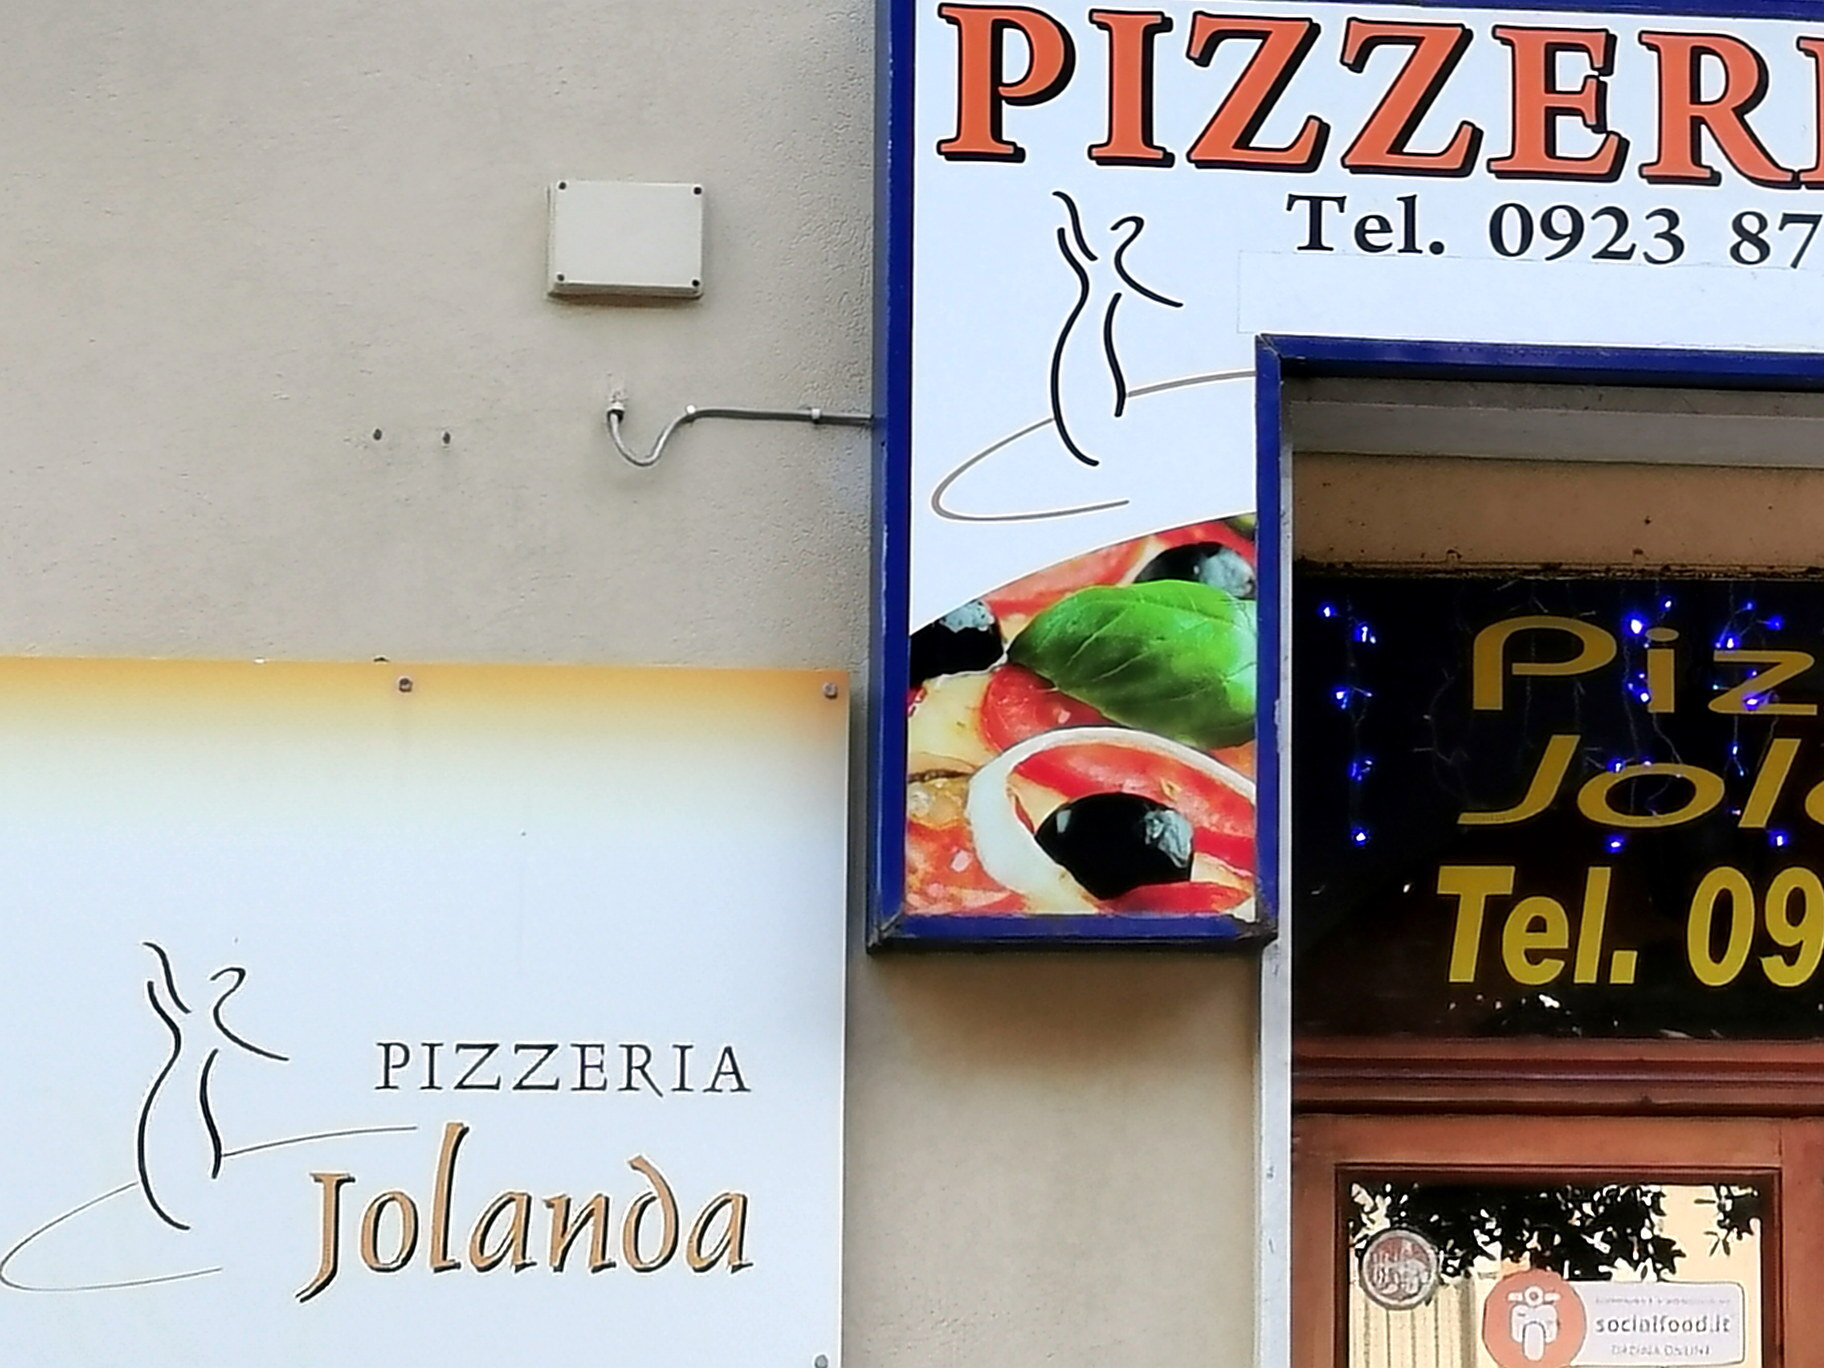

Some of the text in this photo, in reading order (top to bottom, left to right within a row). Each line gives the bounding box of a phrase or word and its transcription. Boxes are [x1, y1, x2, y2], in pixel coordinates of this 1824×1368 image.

[1287, 194, 1444, 256] Tel.
[1490, 203, 1685, 265] 0923
[1437, 865, 1638, 986] Tel.
[375, 1042, 751, 1098] PIZZERIA
[294, 1122, 754, 1304] Jolanda
